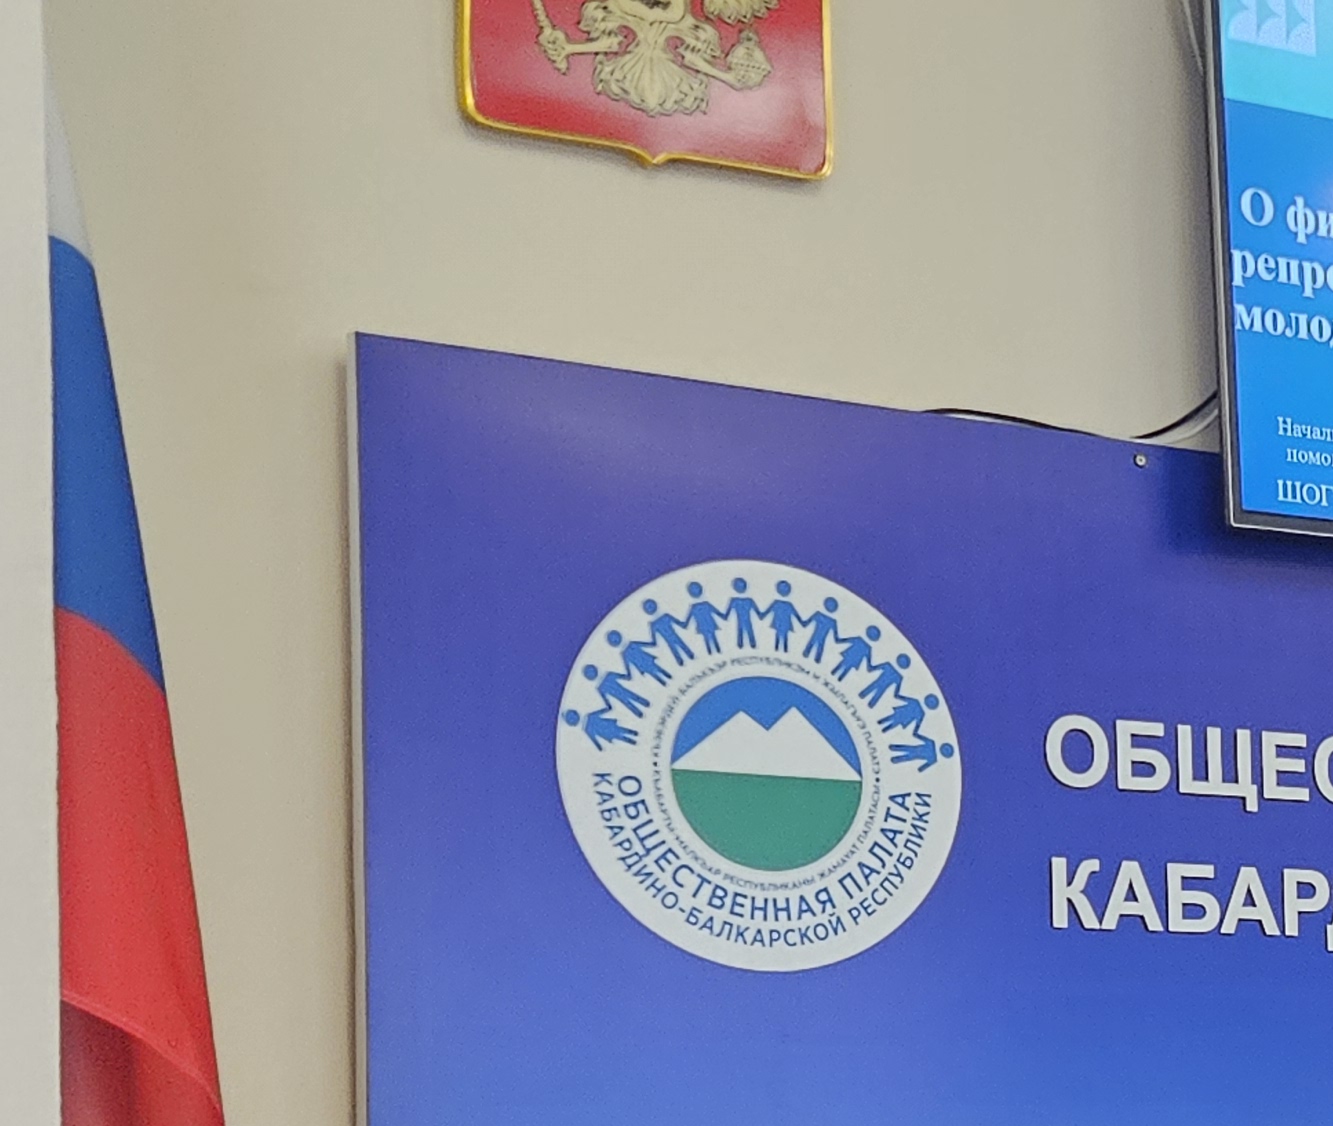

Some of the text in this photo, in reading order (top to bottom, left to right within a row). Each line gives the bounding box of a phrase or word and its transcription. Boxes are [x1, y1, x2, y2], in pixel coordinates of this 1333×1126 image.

[1239, 187, 1275, 227] О
[592, 772, 932, 948] КАБАРДИНО-БАЛКАРСКОЙ РЕСПУБЛИКИ
[617, 775, 912, 922] ОБЩЕСТВЕННАЯ ПАЛАТА
